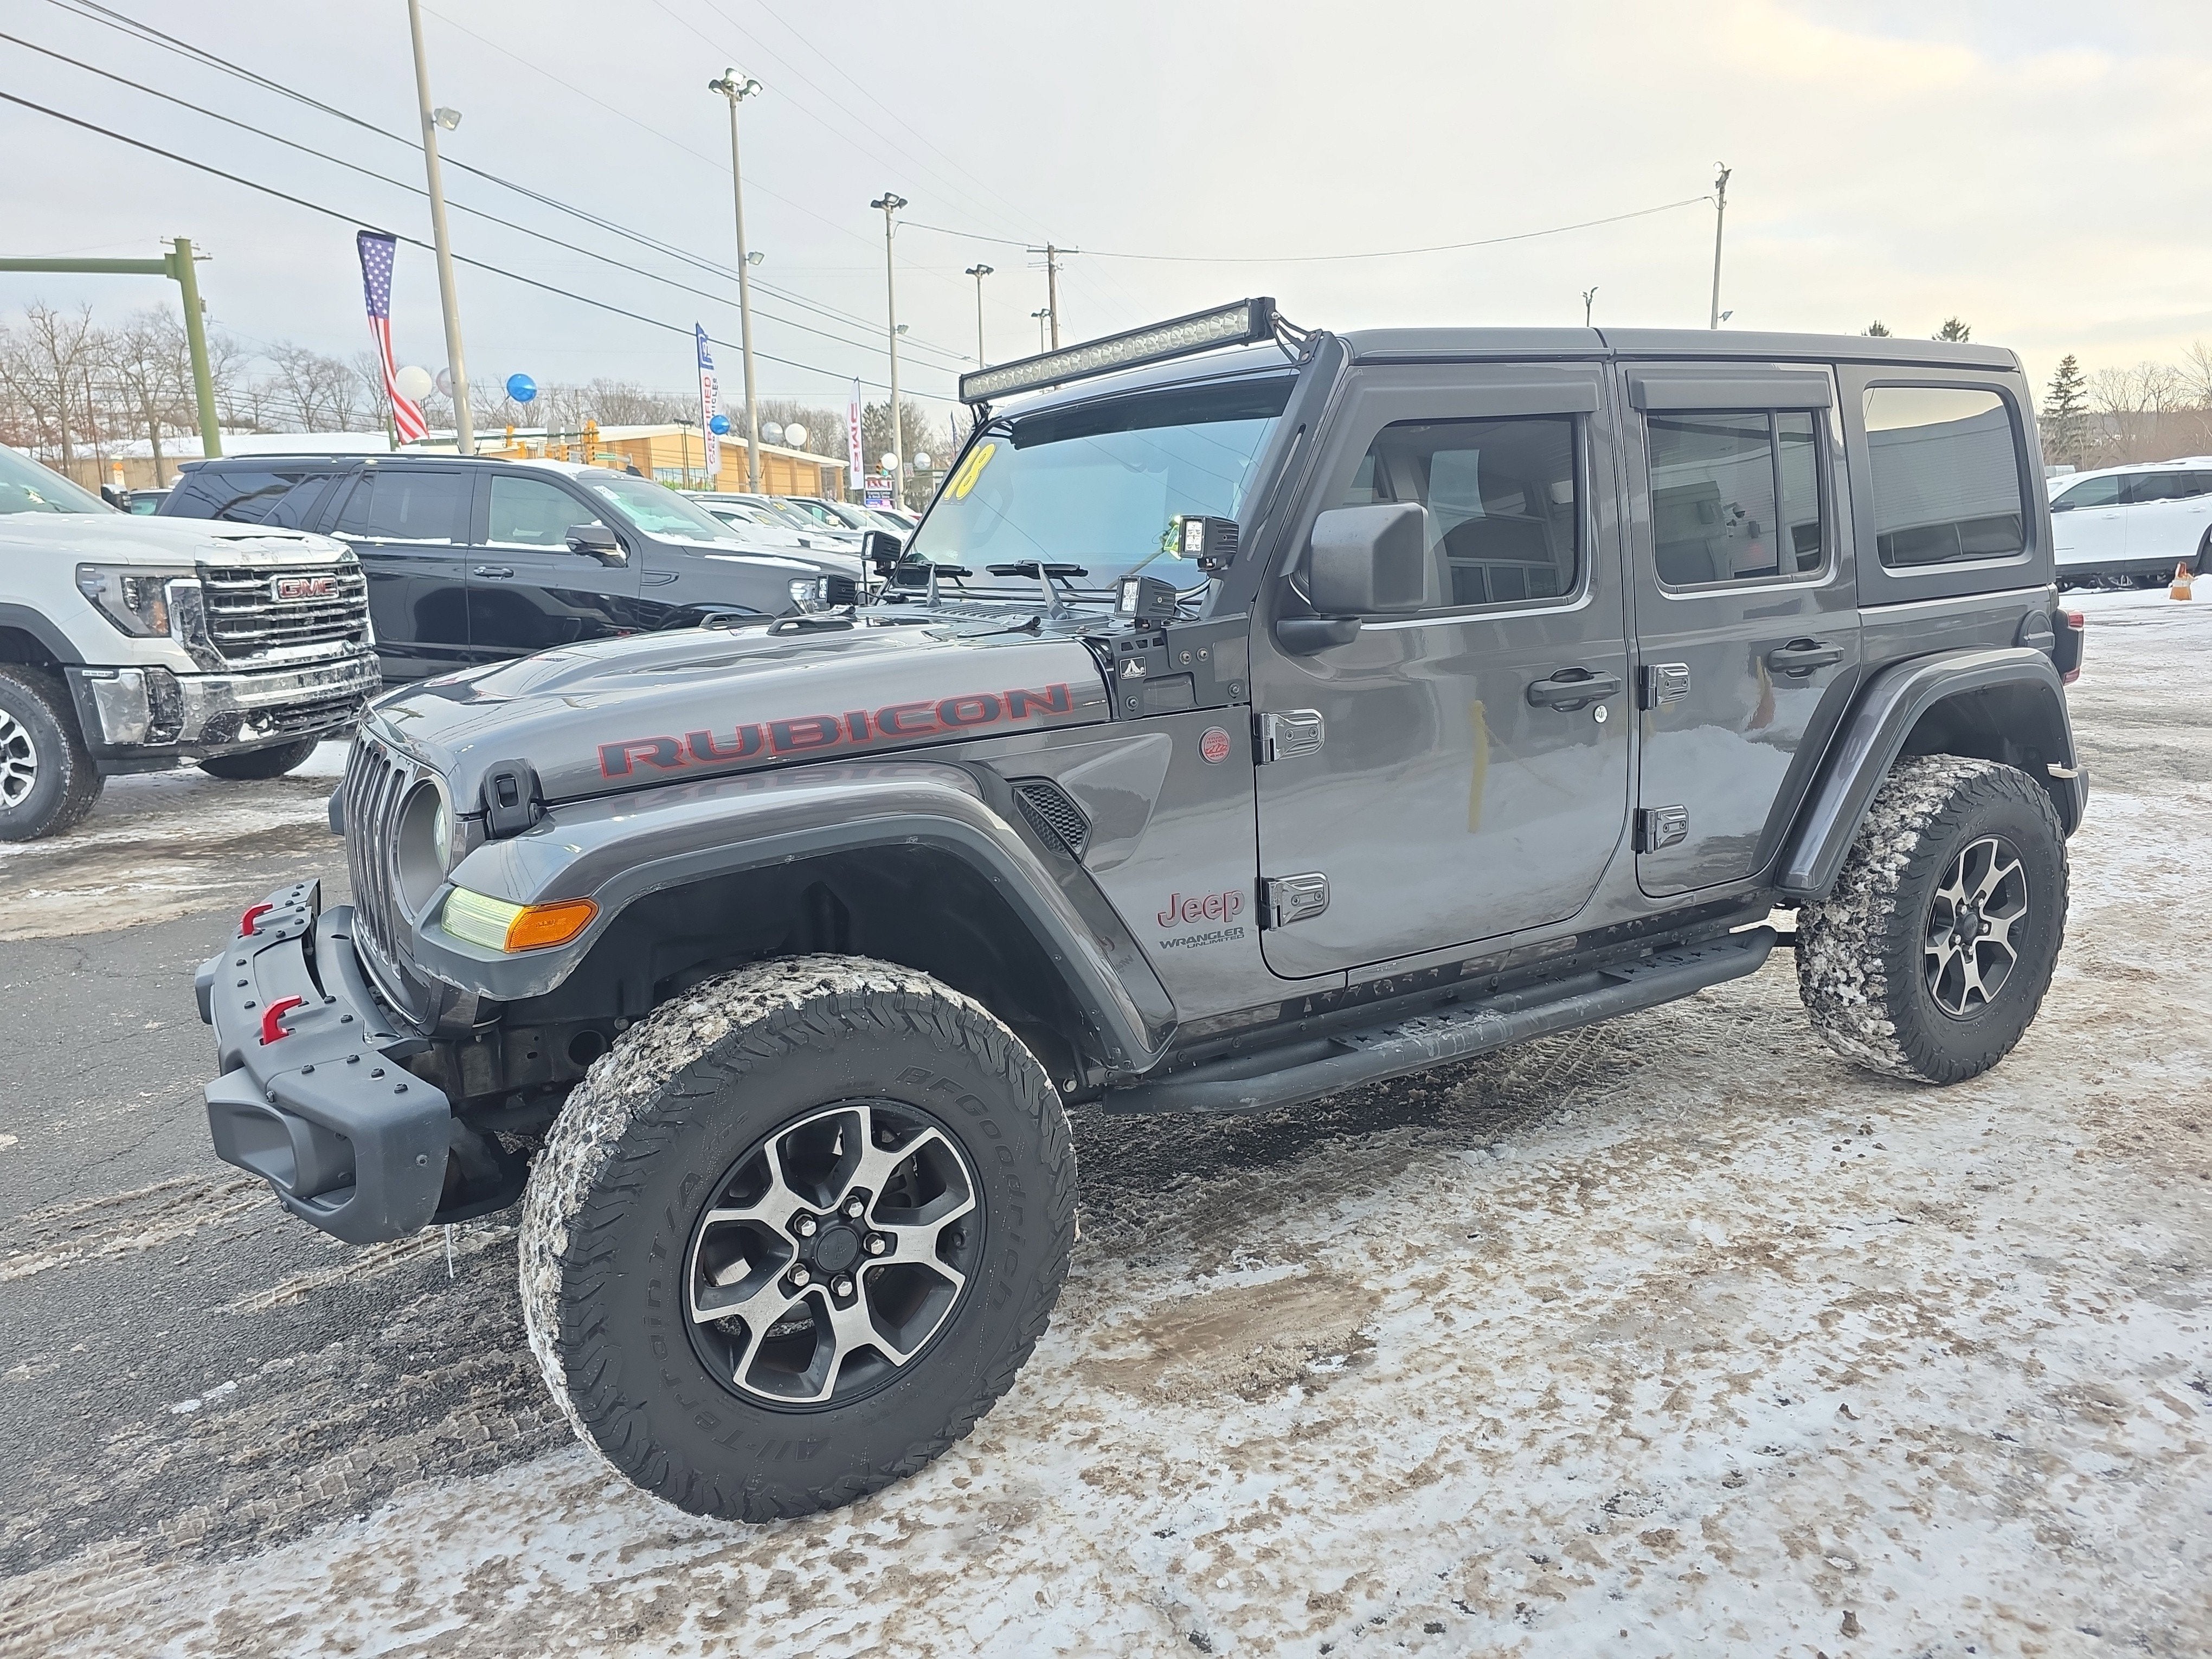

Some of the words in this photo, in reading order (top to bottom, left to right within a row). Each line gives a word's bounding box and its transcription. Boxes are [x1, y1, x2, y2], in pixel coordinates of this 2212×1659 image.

[597, 683, 1074, 779] RUBICON
[1158, 890, 1245, 928] Jeep
[1159, 927, 1244, 949] WRANGLER
[1187, 934, 1245, 948] UNLIMITED
